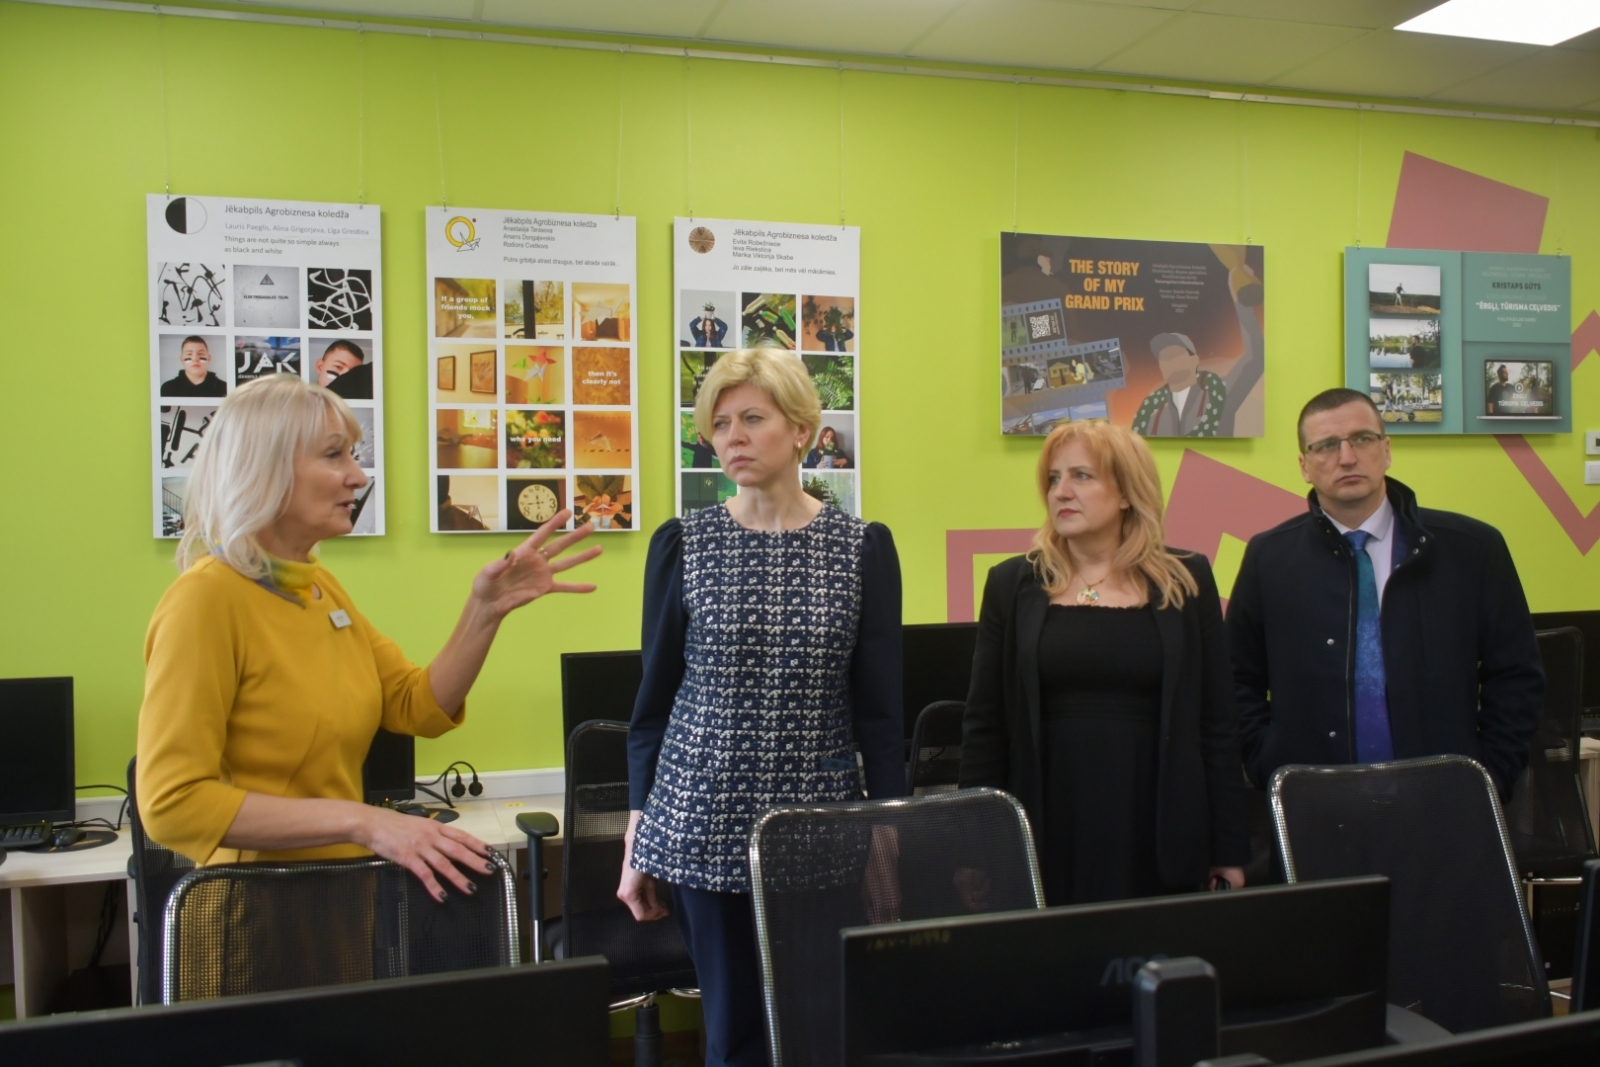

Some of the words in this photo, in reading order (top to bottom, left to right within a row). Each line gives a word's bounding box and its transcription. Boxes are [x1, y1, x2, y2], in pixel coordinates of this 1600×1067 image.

[224, 205, 263, 215] Jēkabpils
[265, 206, 316, 217] Agrobiznesa
[318, 209, 349, 219] koledža
[503, 216, 532, 225] Jēkabpils
[533, 217, 571, 227] Agrobiznesa
[573, 219, 597, 228] koledža
[246, 223, 271, 232] Paeglis,
[290, 225, 326, 234] Grigorjeva,
[224, 235, 246, 243] Things
[296, 238, 317, 246] simple
[318, 239, 339, 247] always
[733, 228, 765, 238] Jēkabpils
[766, 230, 809, 240] Agrobiznesa
[811, 233, 838, 242] koledža
[1068, 259, 1094, 274] THE
[1097, 260, 1140, 276] STORY
[1083, 277, 1101, 292] OF
[1104, 278, 1126, 293] MY
[1492, 281, 1523, 289] KRISTAPS
[1524, 281, 1542, 290] GŪTS
[1065, 294, 1110, 310] GRAND
[1114, 296, 1145, 311] PRIX
[1500, 301, 1528, 311] TŪRISMA
[237, 351, 298, 374] JAK
[582, 378, 607, 386] clearly
[549, 498, 556, 509] 3
[523, 506, 530, 516] 8
